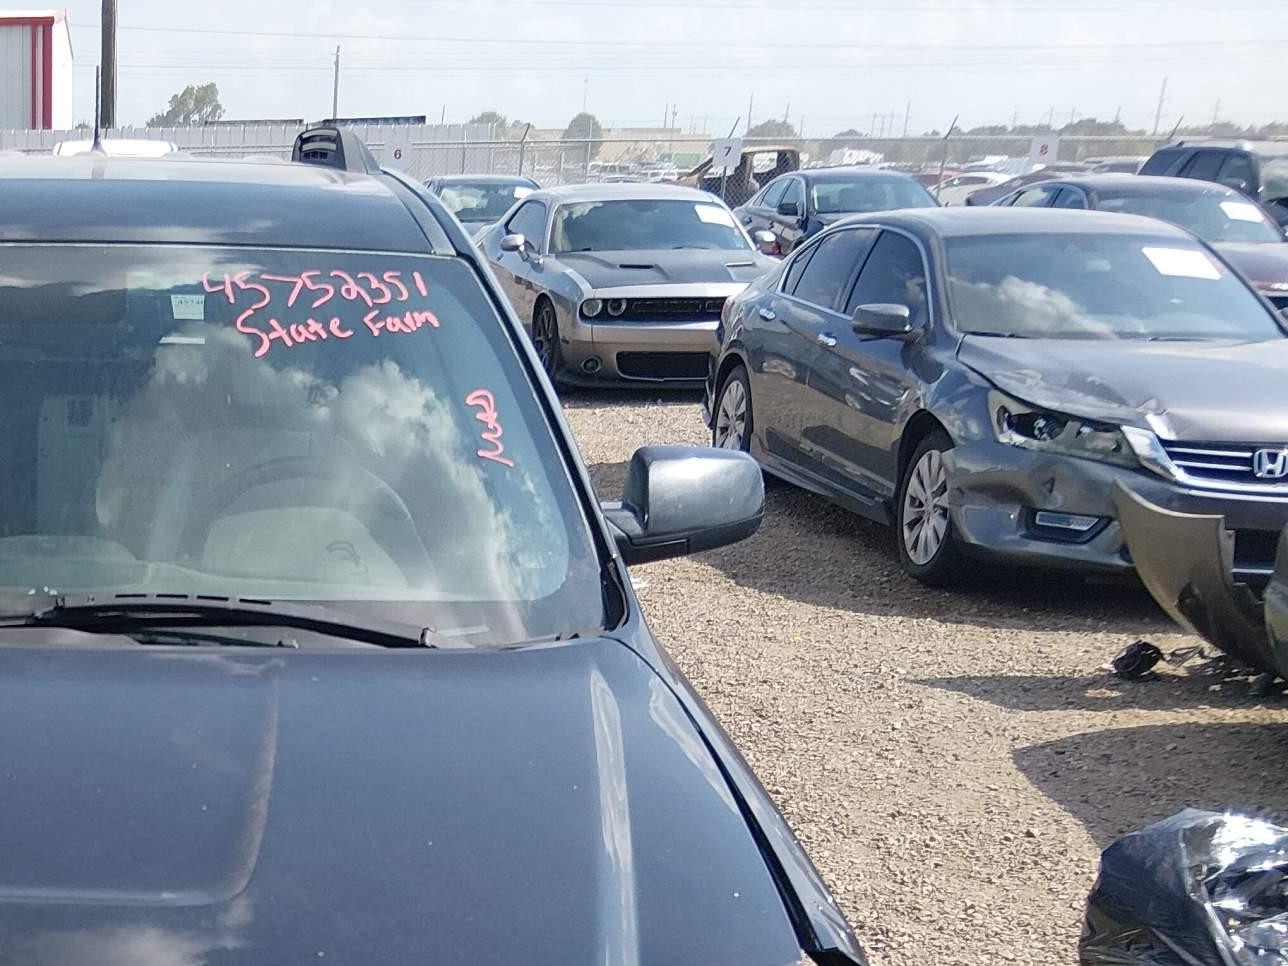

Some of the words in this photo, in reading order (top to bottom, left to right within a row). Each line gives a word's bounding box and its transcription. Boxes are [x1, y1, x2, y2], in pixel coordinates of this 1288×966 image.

[394, 149, 402, 160] 6
[724, 145, 732, 157] 7
[201, 270, 428, 309] 45752351
[235, 308, 353, 358] State
